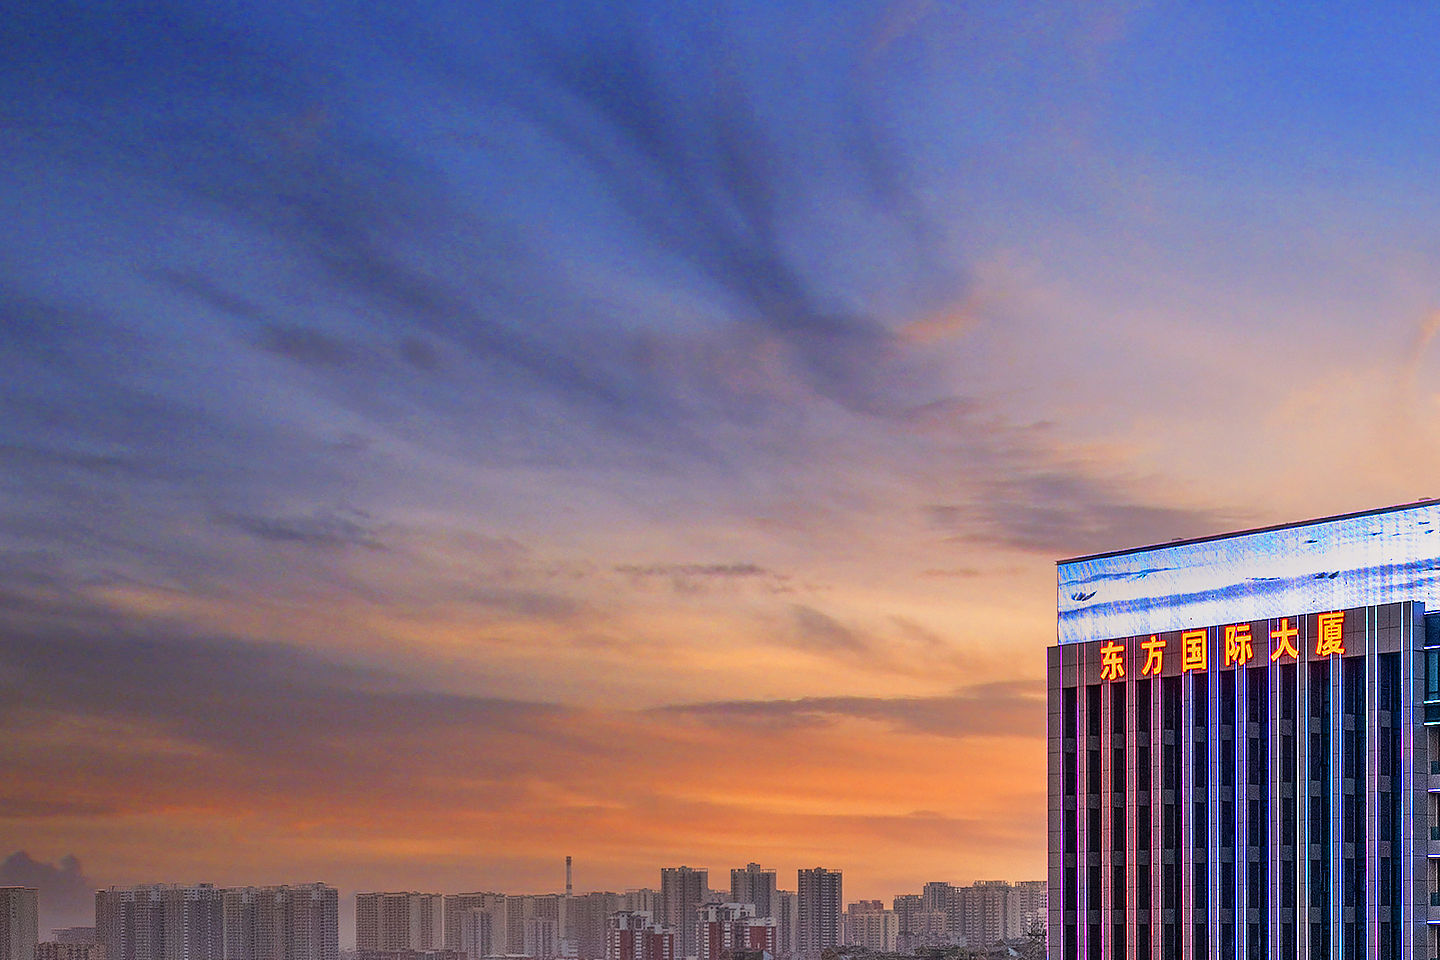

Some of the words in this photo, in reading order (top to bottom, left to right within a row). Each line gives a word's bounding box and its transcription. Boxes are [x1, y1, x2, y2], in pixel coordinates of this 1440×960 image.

[1100, 612, 1345, 680] 东方国际大厦
